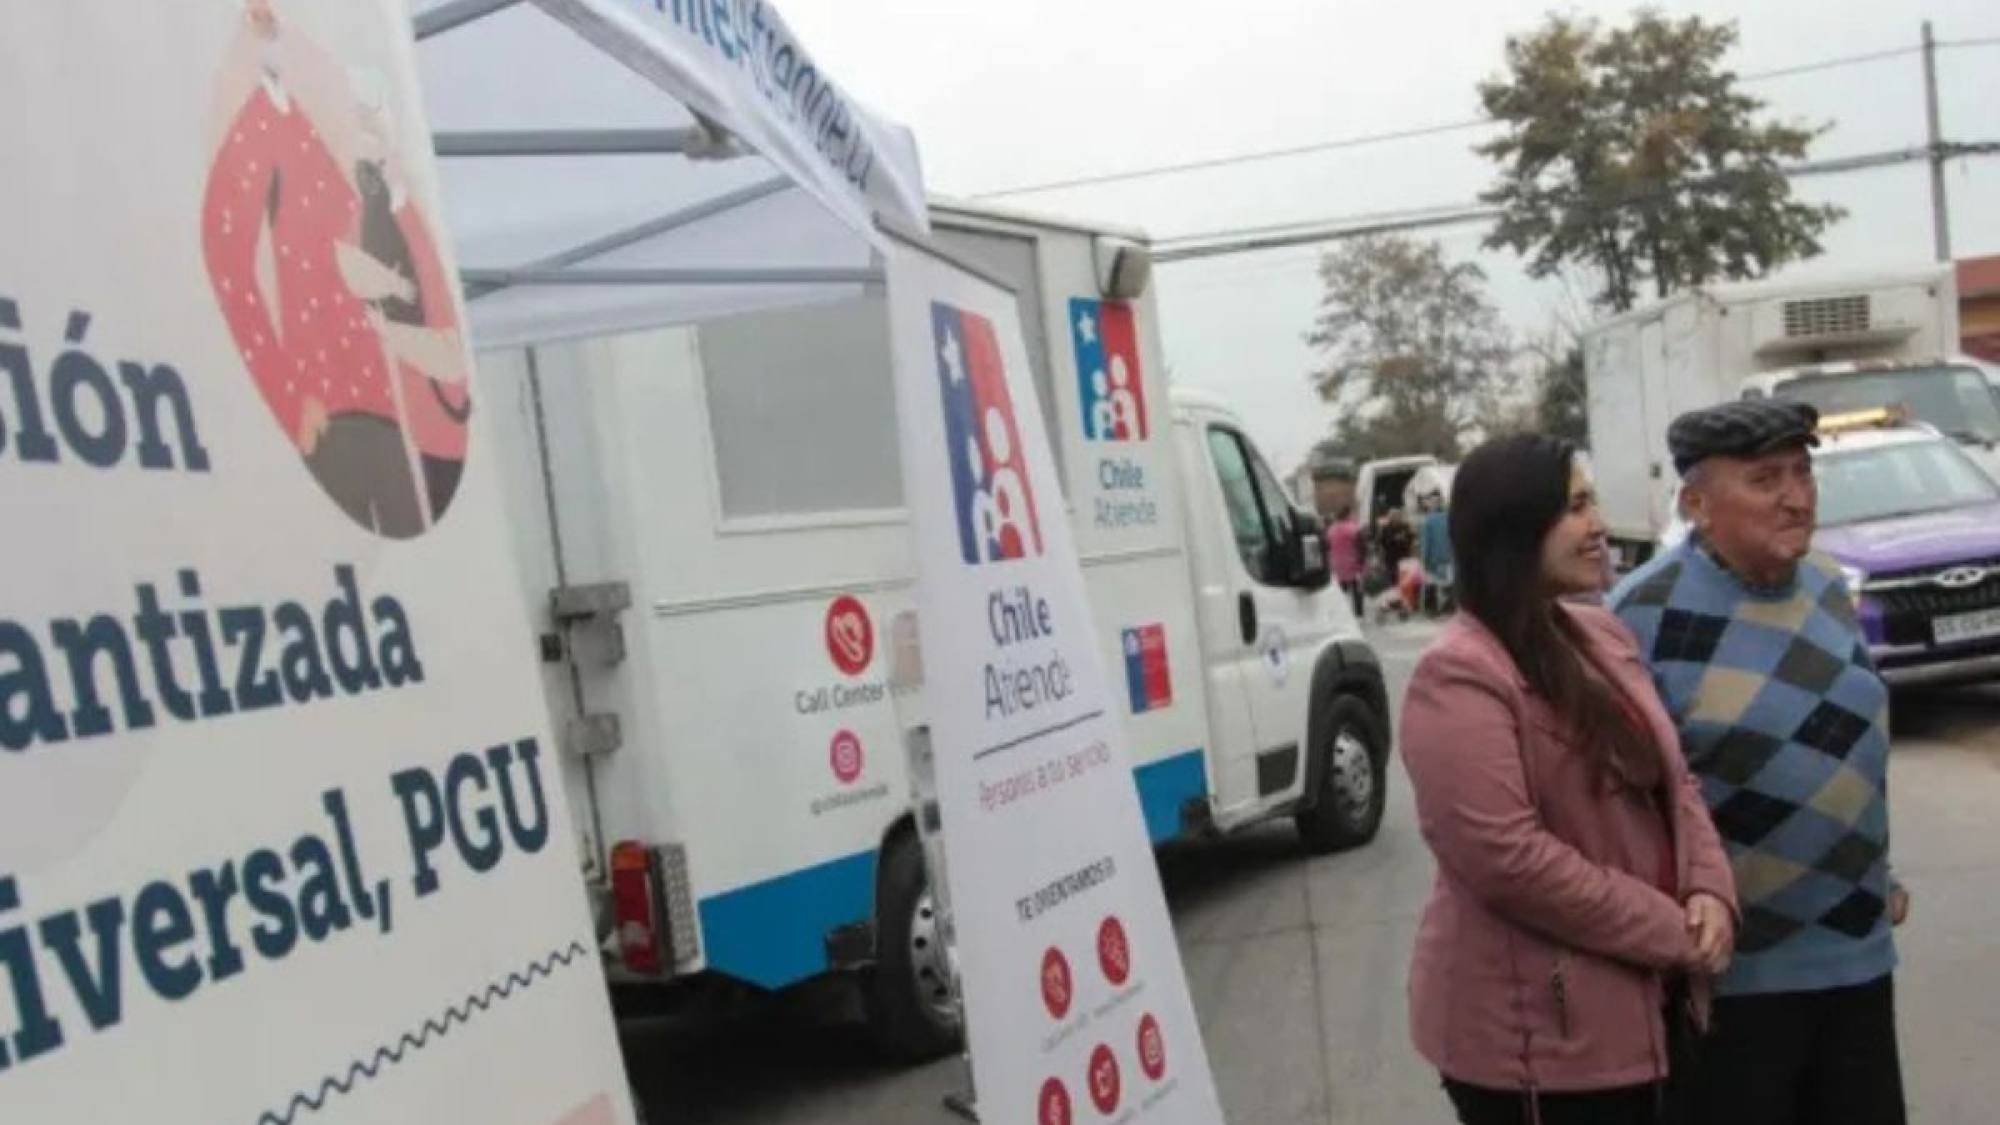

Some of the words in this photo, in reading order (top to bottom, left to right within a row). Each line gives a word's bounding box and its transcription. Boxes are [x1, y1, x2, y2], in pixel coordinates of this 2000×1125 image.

[0, 298, 210, 472] ión
[988, 585, 1053, 647] Chile
[795, 687, 829, 715] Call
[0, 787, 392, 1071] iversal,
[391, 737, 549, 898] PGU
